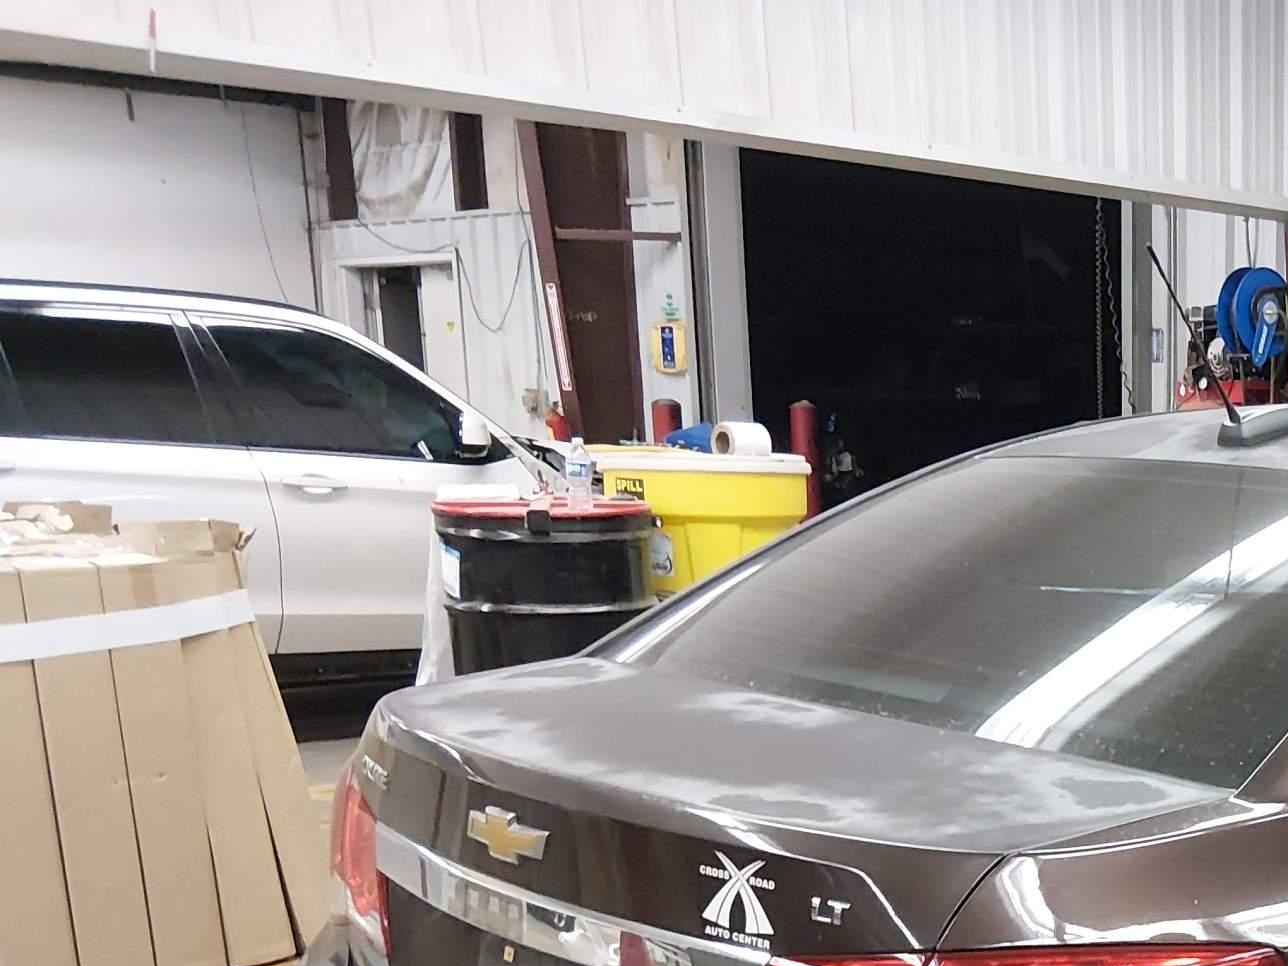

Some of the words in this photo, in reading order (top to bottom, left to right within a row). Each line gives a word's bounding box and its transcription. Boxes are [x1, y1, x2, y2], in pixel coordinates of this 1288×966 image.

[616, 479, 643, 492] SPILL
[699, 864, 730, 880] CROSS
[749, 876, 776, 890] ROAD
[810, 896, 851, 926] LT
[705, 925, 730, 939] AUTO
[732, 932, 771, 950] CENTER
